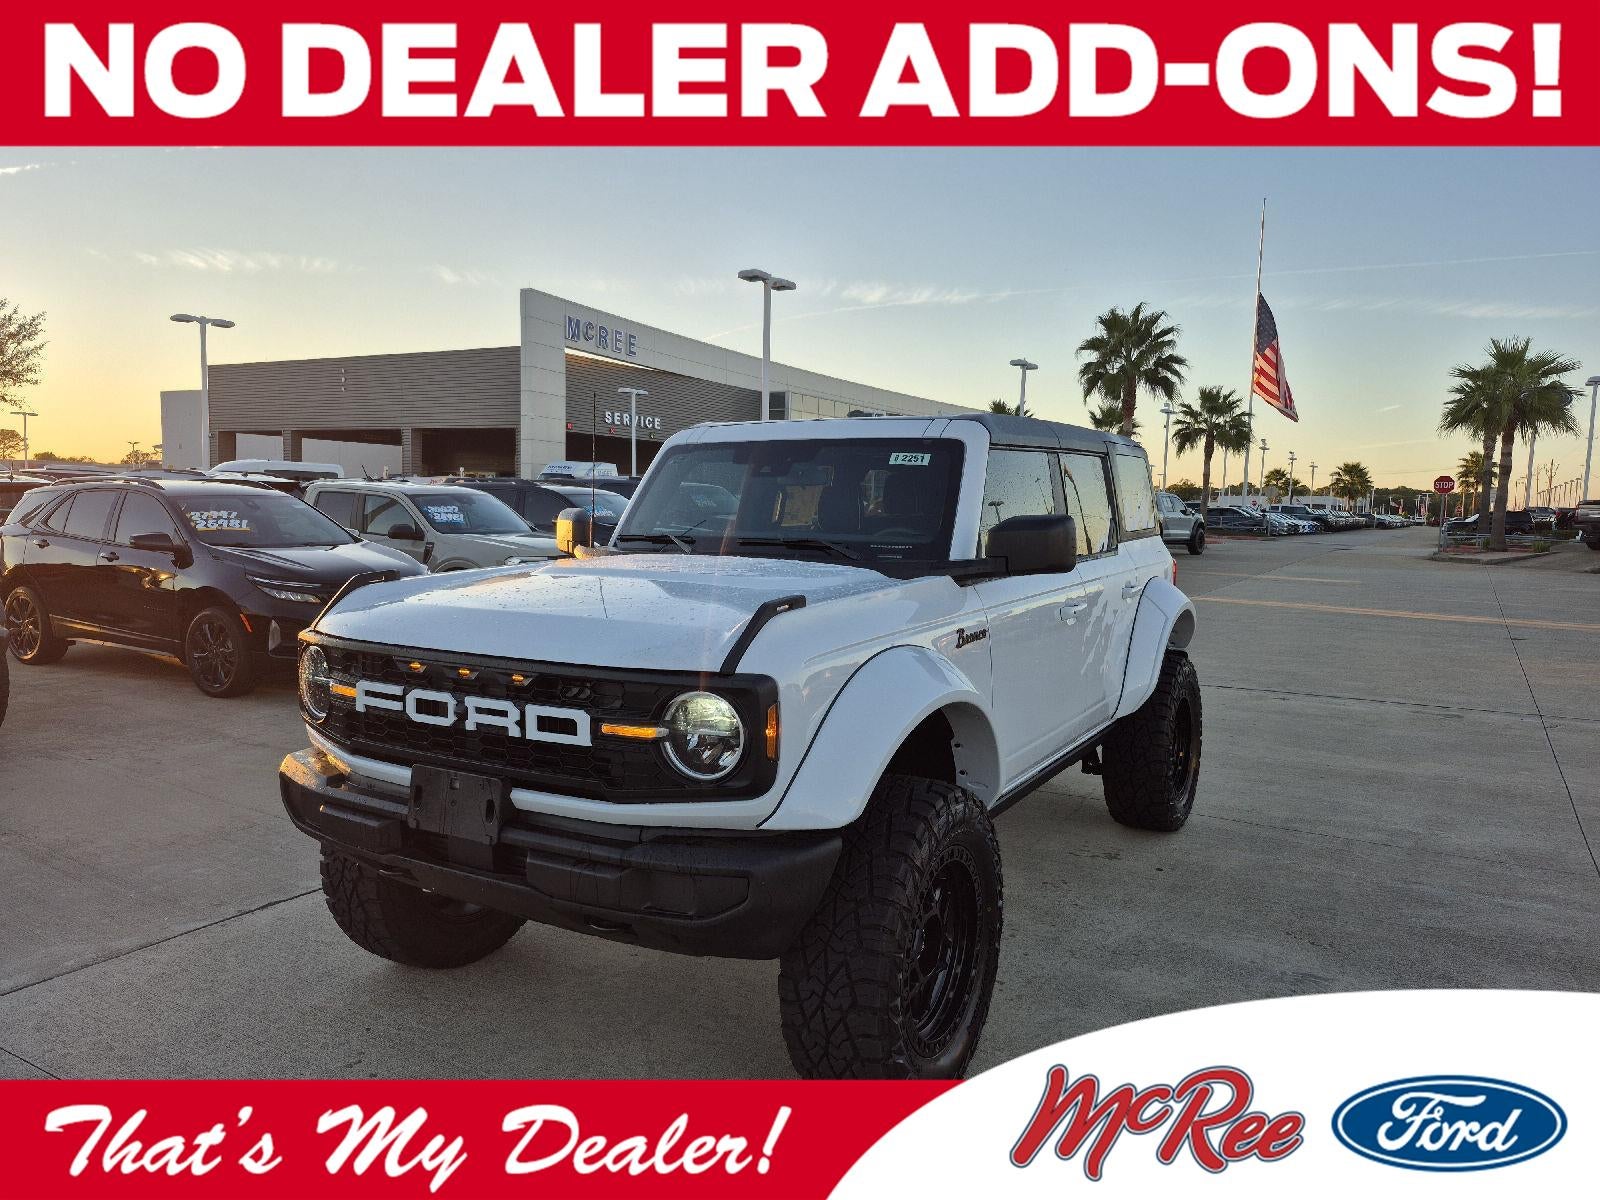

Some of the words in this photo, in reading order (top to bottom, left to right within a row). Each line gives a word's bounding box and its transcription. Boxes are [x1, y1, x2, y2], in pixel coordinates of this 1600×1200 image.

[605, 411, 661, 430] SERVICE
[1435, 481, 1454, 489] STOP
[955, 628, 989, 649] Bronco
[355, 679, 593, 747] FORD
